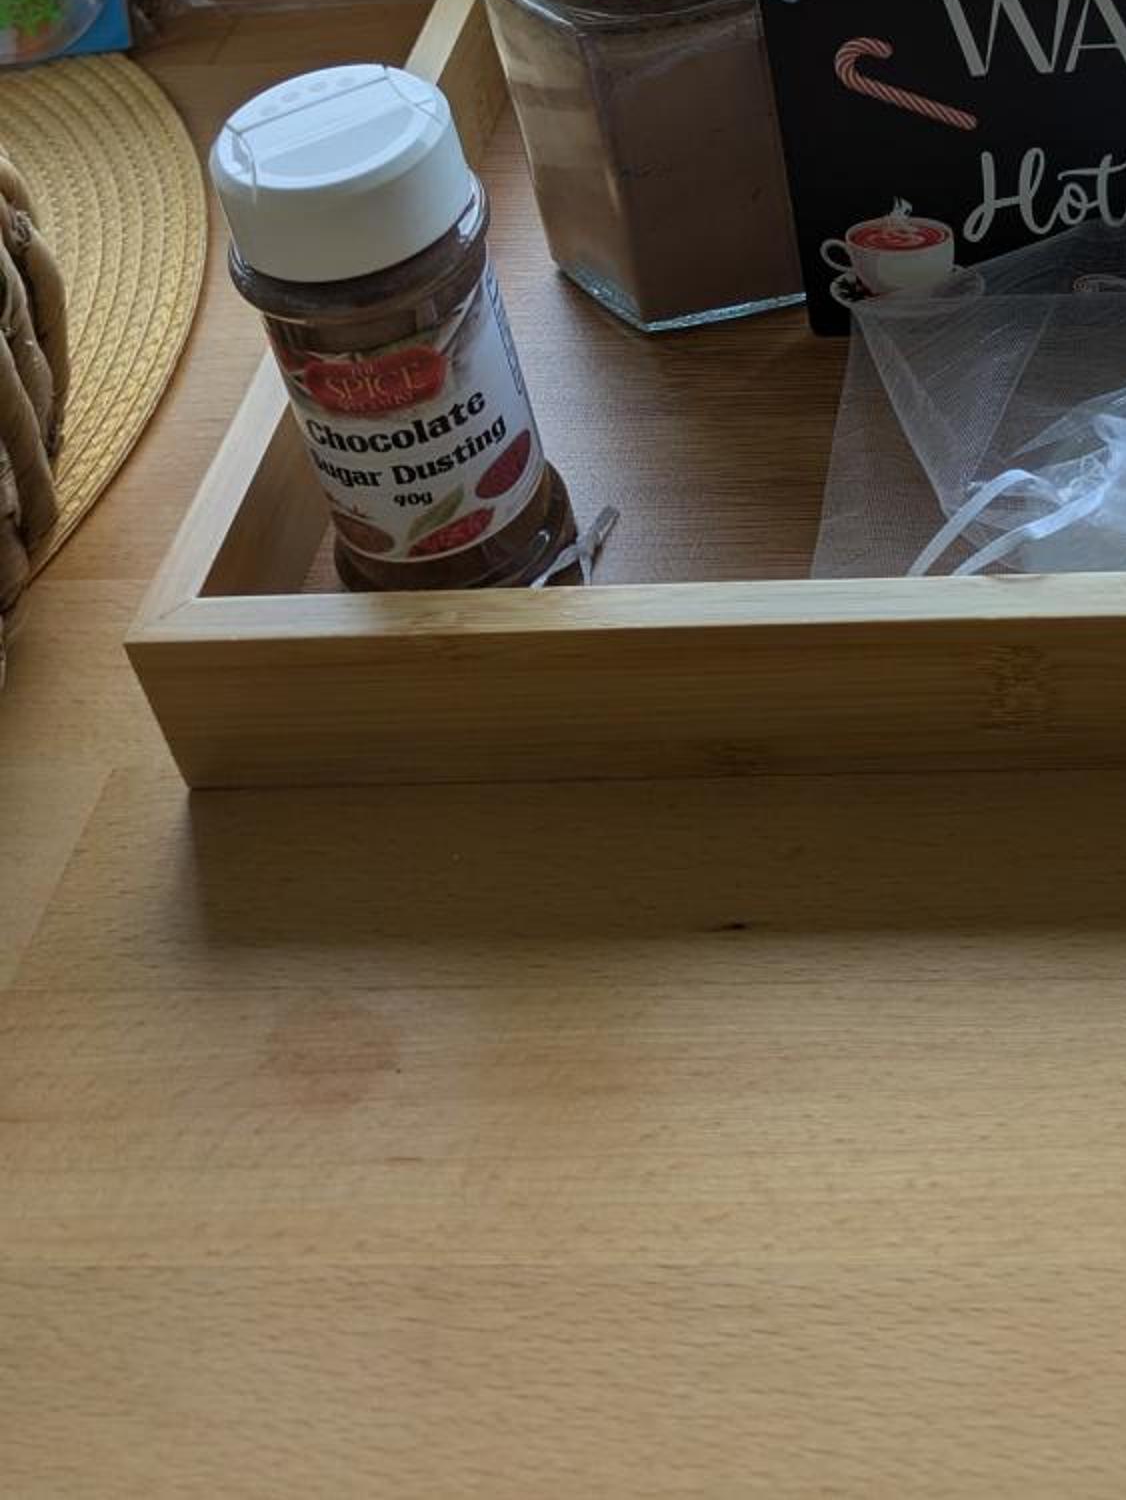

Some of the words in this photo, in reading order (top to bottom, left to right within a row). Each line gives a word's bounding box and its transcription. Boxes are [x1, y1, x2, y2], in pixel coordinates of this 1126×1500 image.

[306, 391, 486, 454] Chocolate
[391, 414, 507, 486] Dusting
[393, 491, 434, 507] 90g
